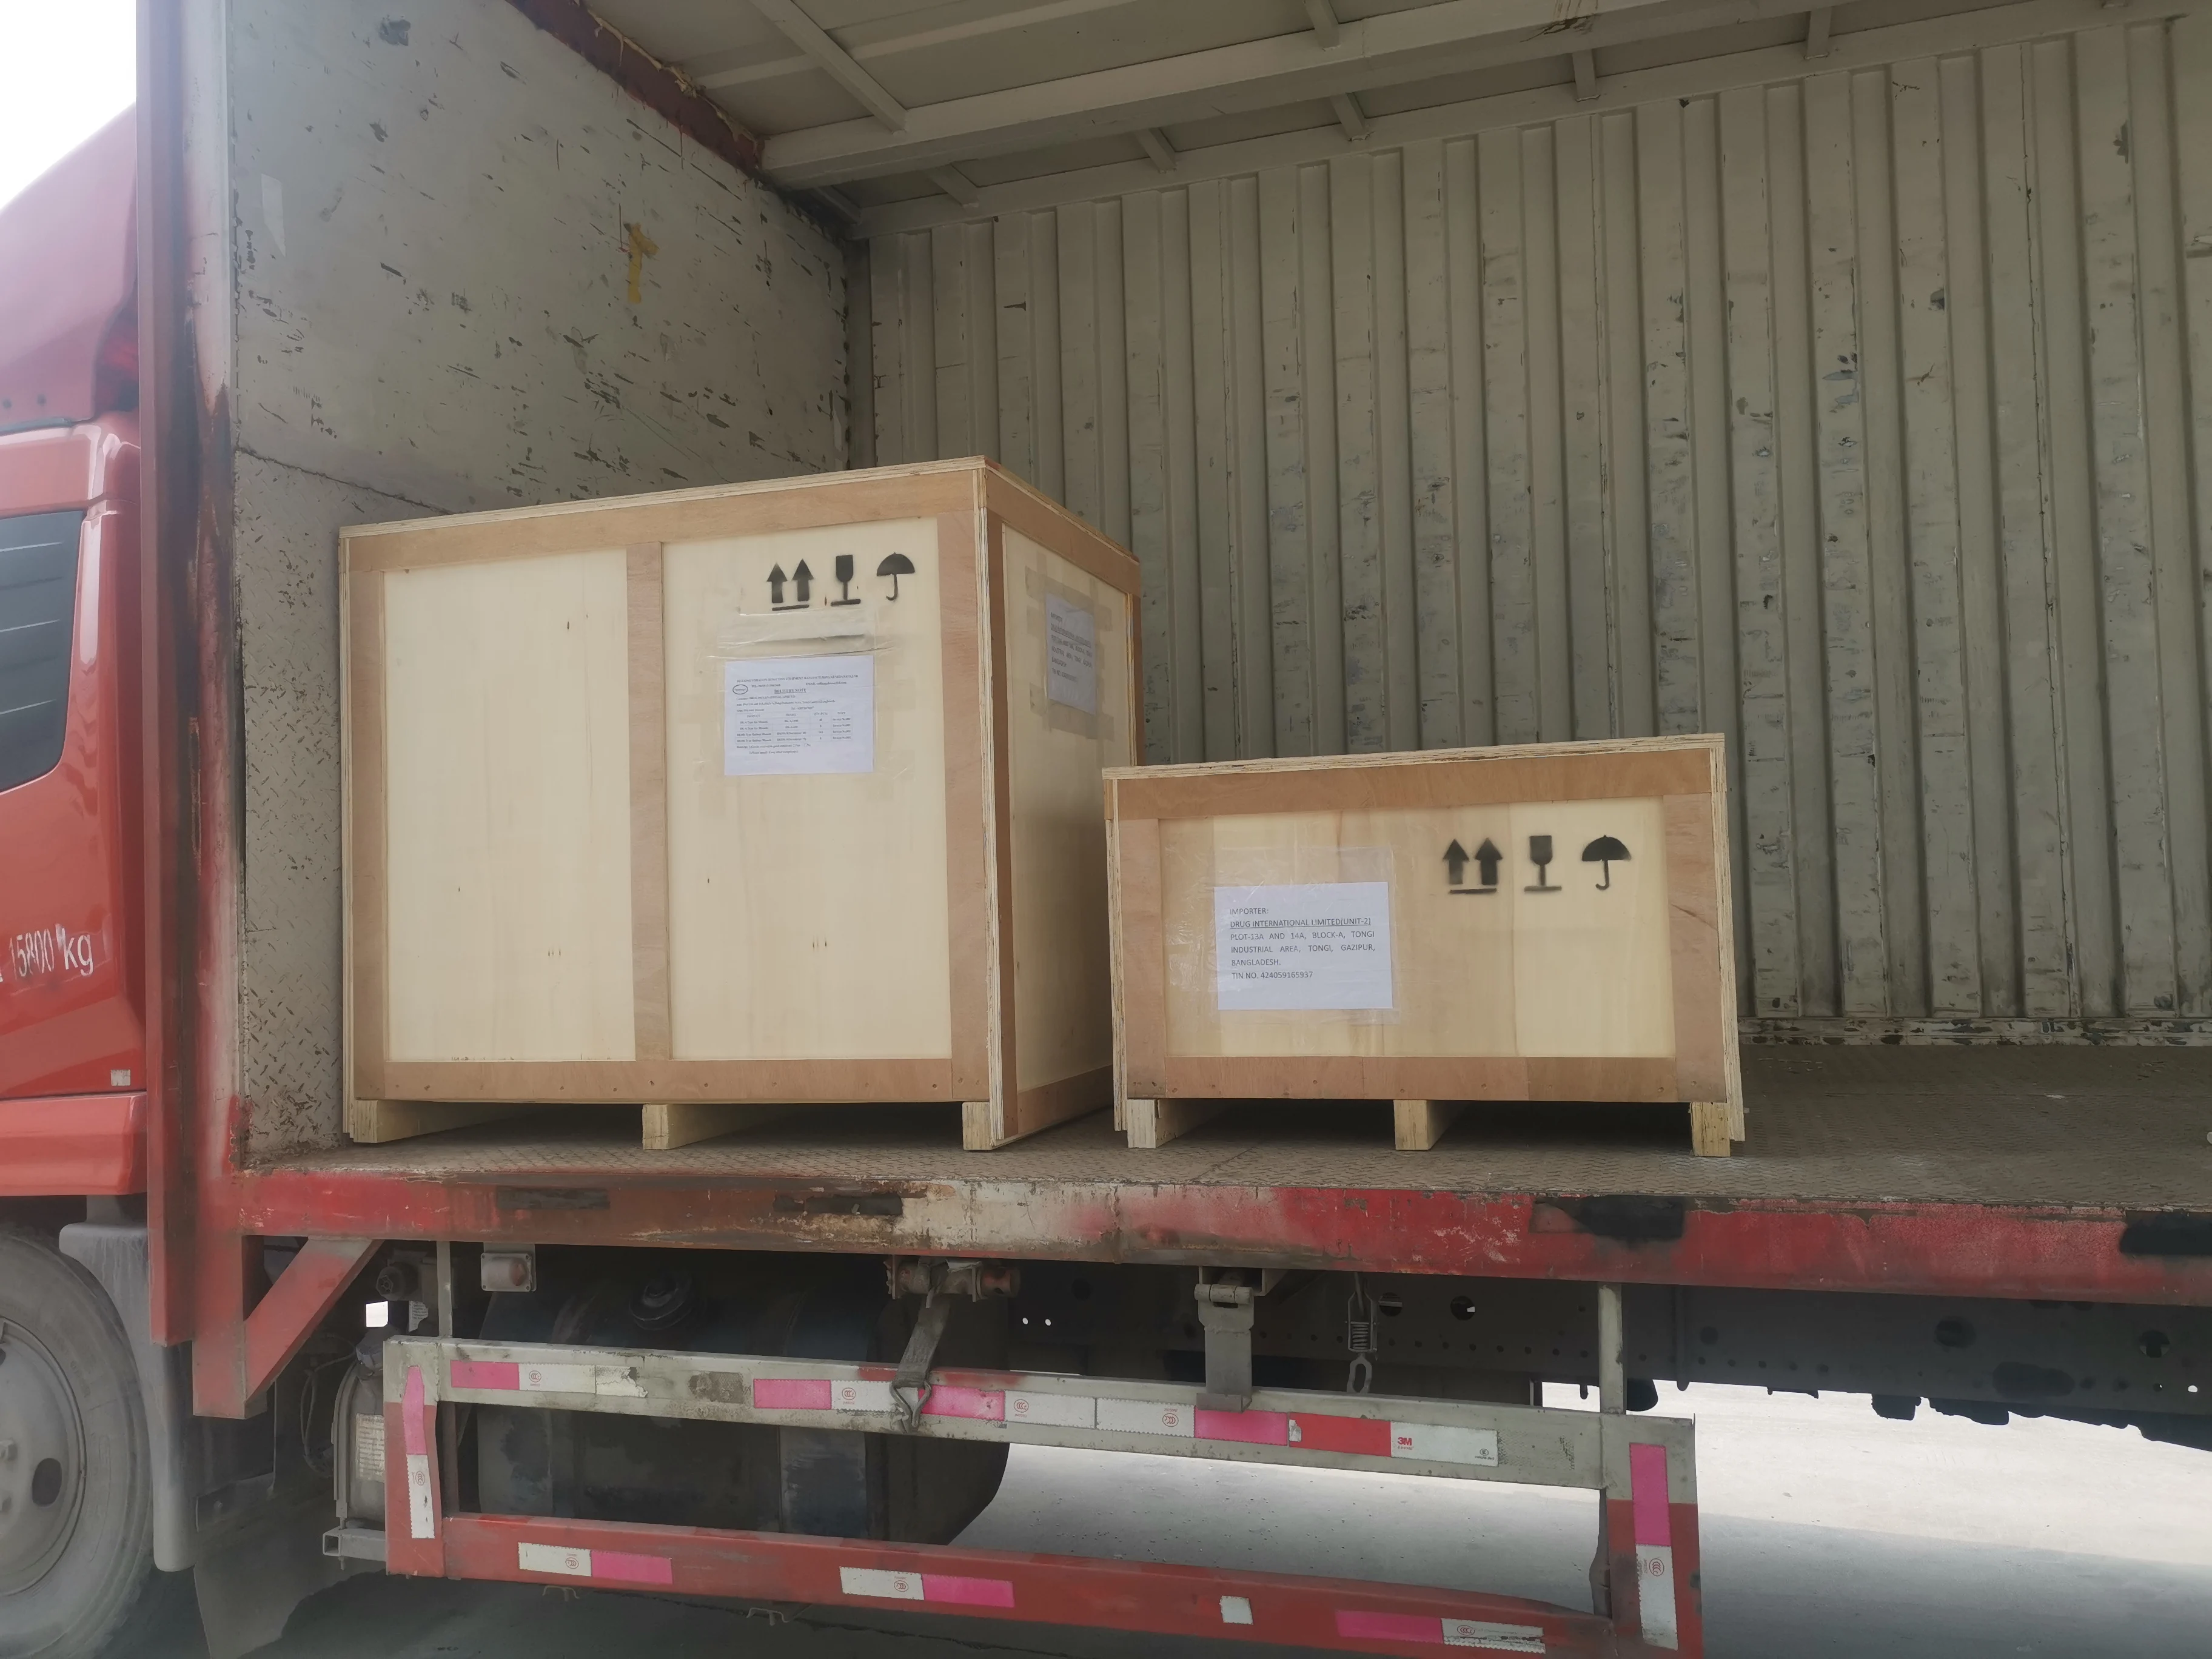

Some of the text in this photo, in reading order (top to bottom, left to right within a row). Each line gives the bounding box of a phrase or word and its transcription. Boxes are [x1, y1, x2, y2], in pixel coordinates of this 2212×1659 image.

[1252, 919, 1310, 928] INTERNATIONAL
[1311, 917, 1372, 926] LIMITED(UNIT-2)
[60, 927, 93, 976] kg
[1341, 943, 1376, 952] GAZIPUR,
[1397, 1436, 1412, 1446] 3M
